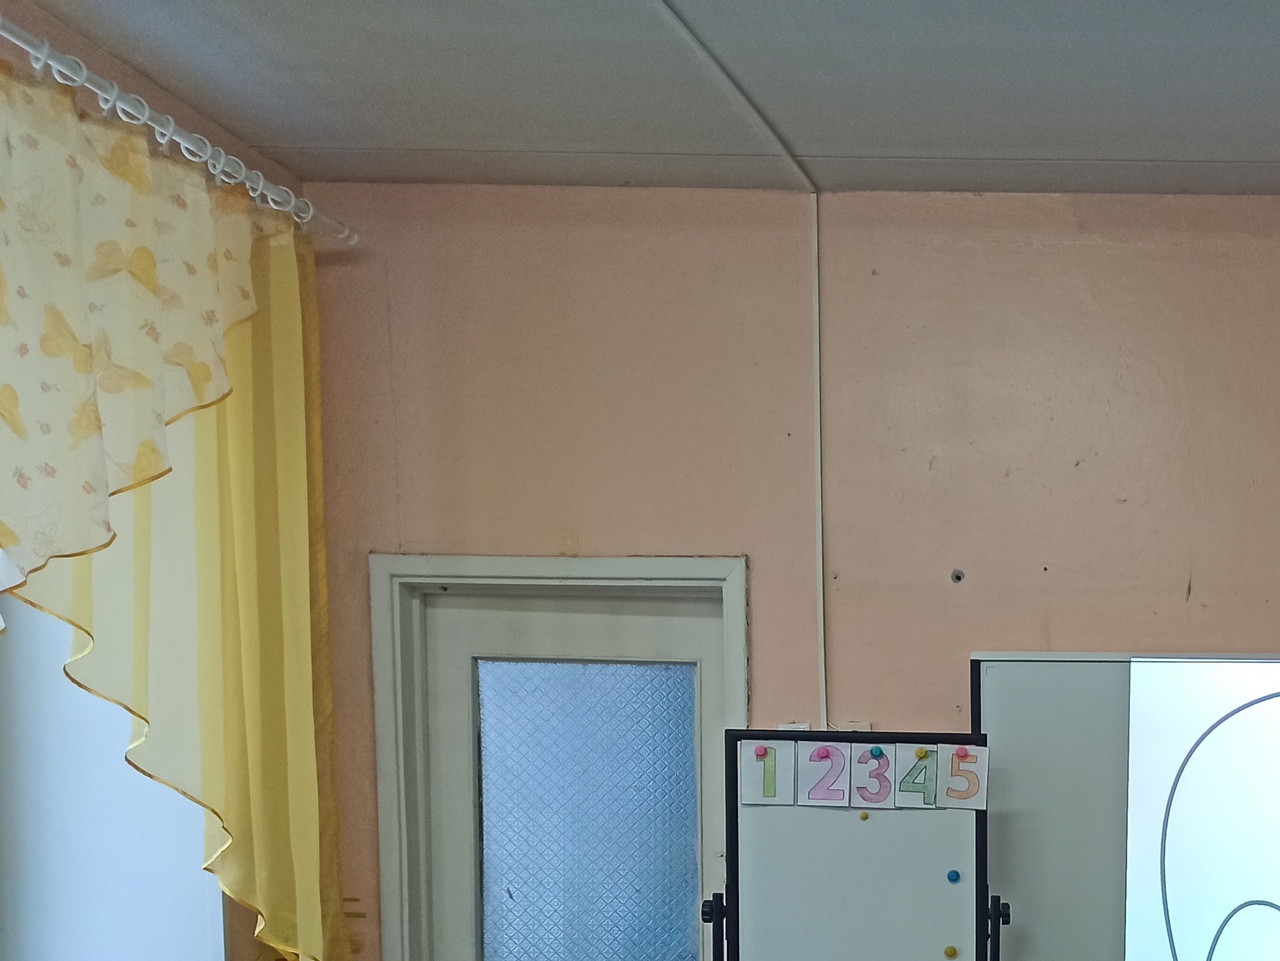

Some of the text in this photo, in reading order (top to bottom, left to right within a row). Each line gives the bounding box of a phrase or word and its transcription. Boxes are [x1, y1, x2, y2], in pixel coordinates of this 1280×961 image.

[755, 745, 980, 805] 1 2 3 4 5
